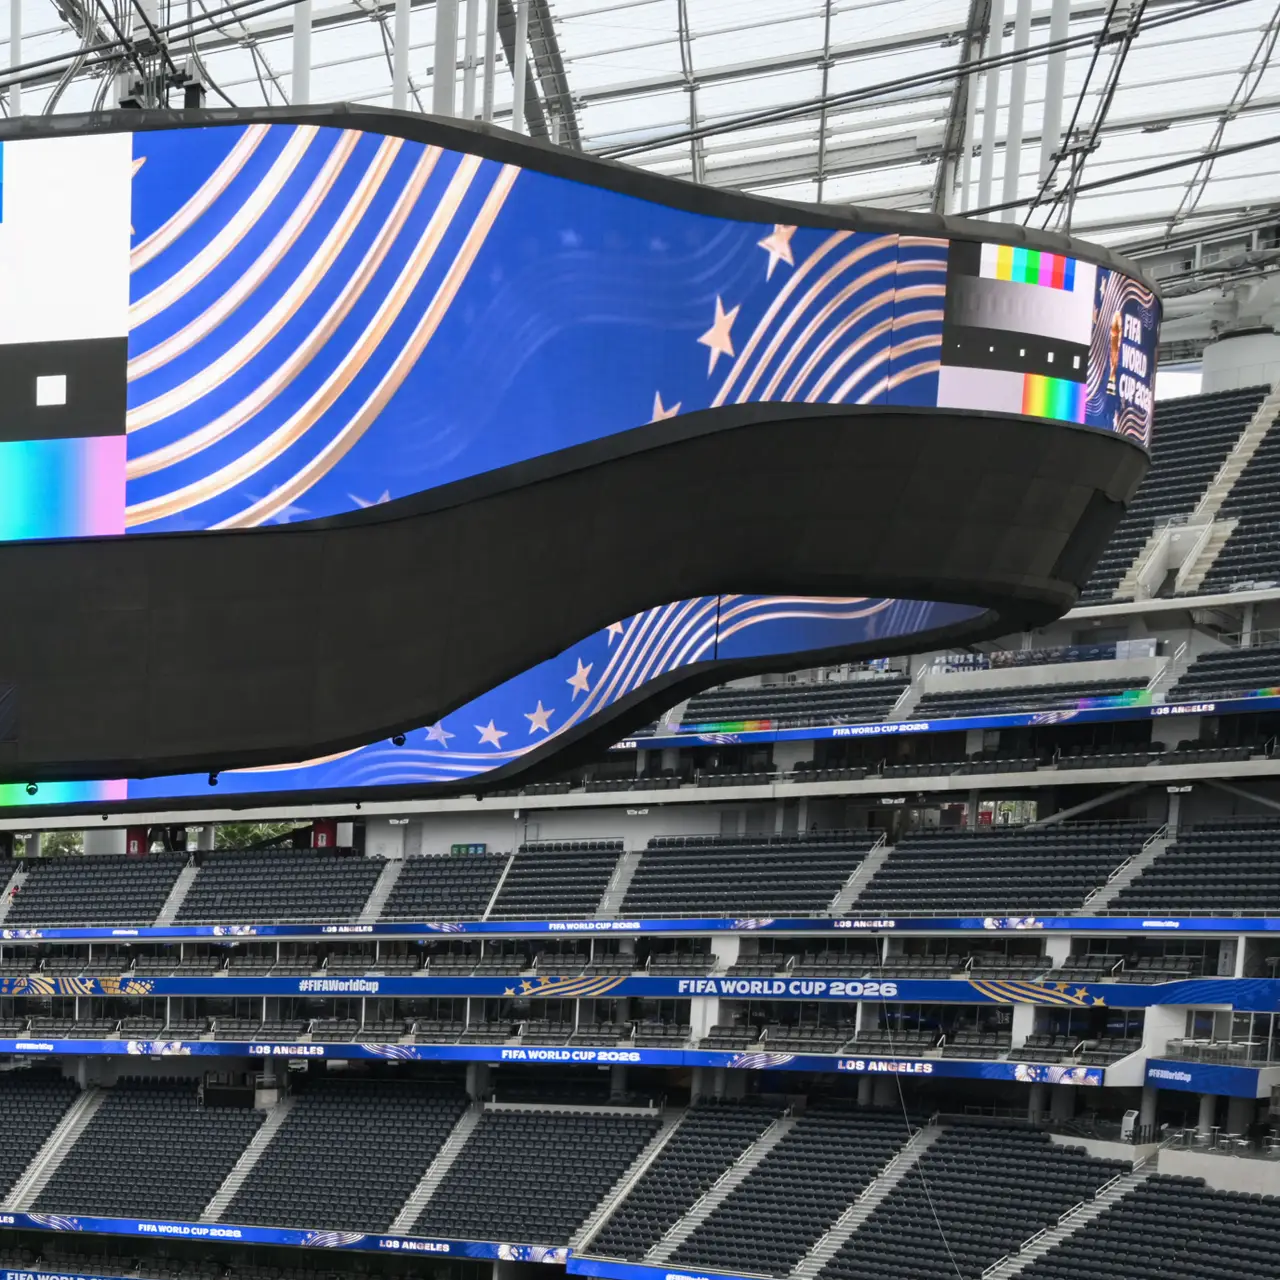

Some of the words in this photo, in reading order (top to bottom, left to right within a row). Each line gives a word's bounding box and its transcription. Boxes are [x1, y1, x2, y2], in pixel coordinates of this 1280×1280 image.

[1124, 313, 1140, 344] FIFA
[1122, 343, 1147, 378] WORLD
[1119, 373, 1136, 403] CUP
[1151, 707, 1169, 715] LOS
[1171, 704, 1215, 714] ANGELES
[832, 728, 850, 736] FIFA
[881, 725, 898, 733] CUP
[899, 723, 929, 731] 2026
[566, 922, 594, 930] WORLD
[595, 922, 611, 930] CUP
[834, 920, 851, 928] LOS
[853, 920, 896, 928] ANGELES
[298, 979, 380, 993] #FIFAWorldCup
[678, 981, 717, 995] FIFA
[719, 981, 786, 996] WORLD
[789, 982, 828, 996] CUP
[829, 982, 898, 997] 2026
[249, 1045, 271, 1054] LOS
[273, 1045, 325, 1056] ANGELES
[502, 1050, 527, 1060] FIFA
[528, 1050, 569, 1061] WORLD
[571, 1050, 596, 1061] CUP
[597, 1051, 641, 1062] 2026
[837, 1060, 865, 1071] LOS
[868, 1061, 933, 1074] ANGELES
[138, 1223, 157, 1233] FIFA
[158, 1224, 190, 1235] WORLD
[191, 1226, 209, 1236] CUP
[379, 1239, 400, 1249] LOS
[402, 1240, 450, 1253] ANGELES
